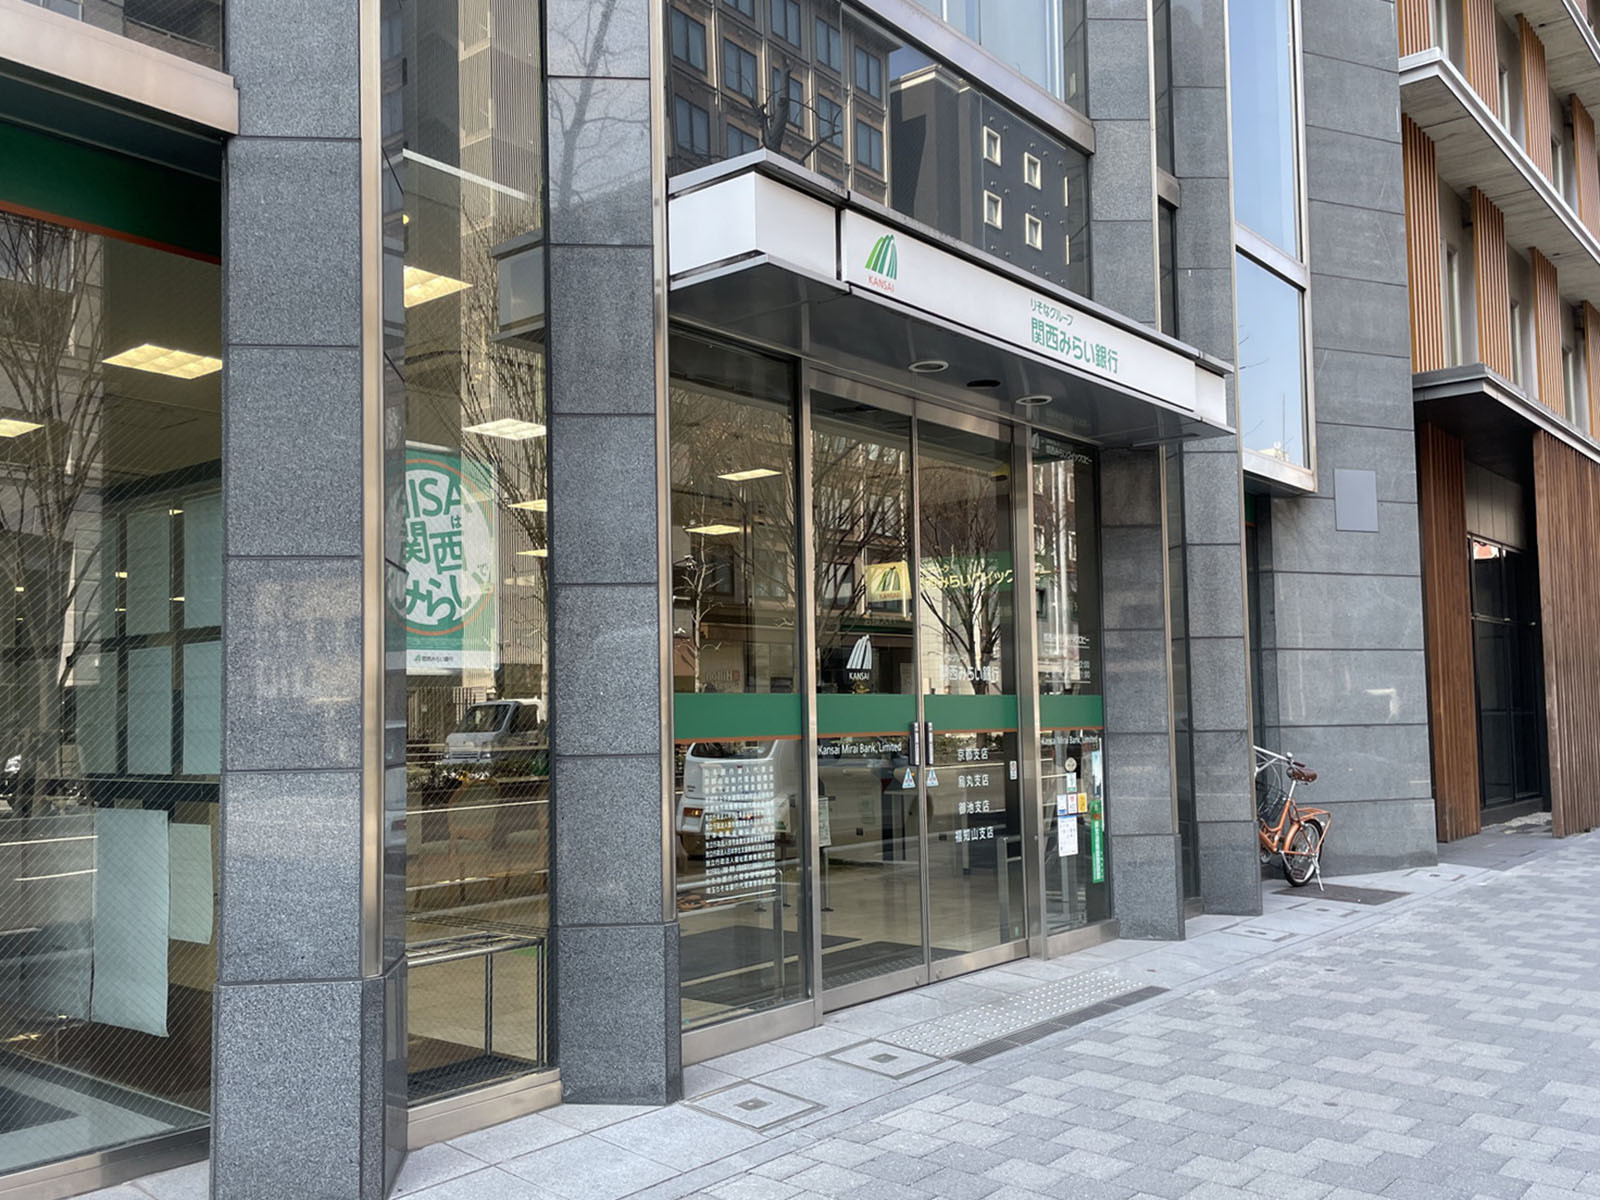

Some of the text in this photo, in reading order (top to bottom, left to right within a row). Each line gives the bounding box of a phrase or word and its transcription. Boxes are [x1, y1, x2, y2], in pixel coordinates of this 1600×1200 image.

[867, 276, 895, 293] KANSAI
[1030, 298, 1074, 325] りそなグループ
[1031, 317, 1119, 374] 関西みらい銀行
[849, 672, 870, 681] KANSAI
[818, 741, 902, 756] Kansai Mirai Bank, Limited
[957, 747, 989, 761] 京都支店
[955, 826, 995, 843] 福知山支店
